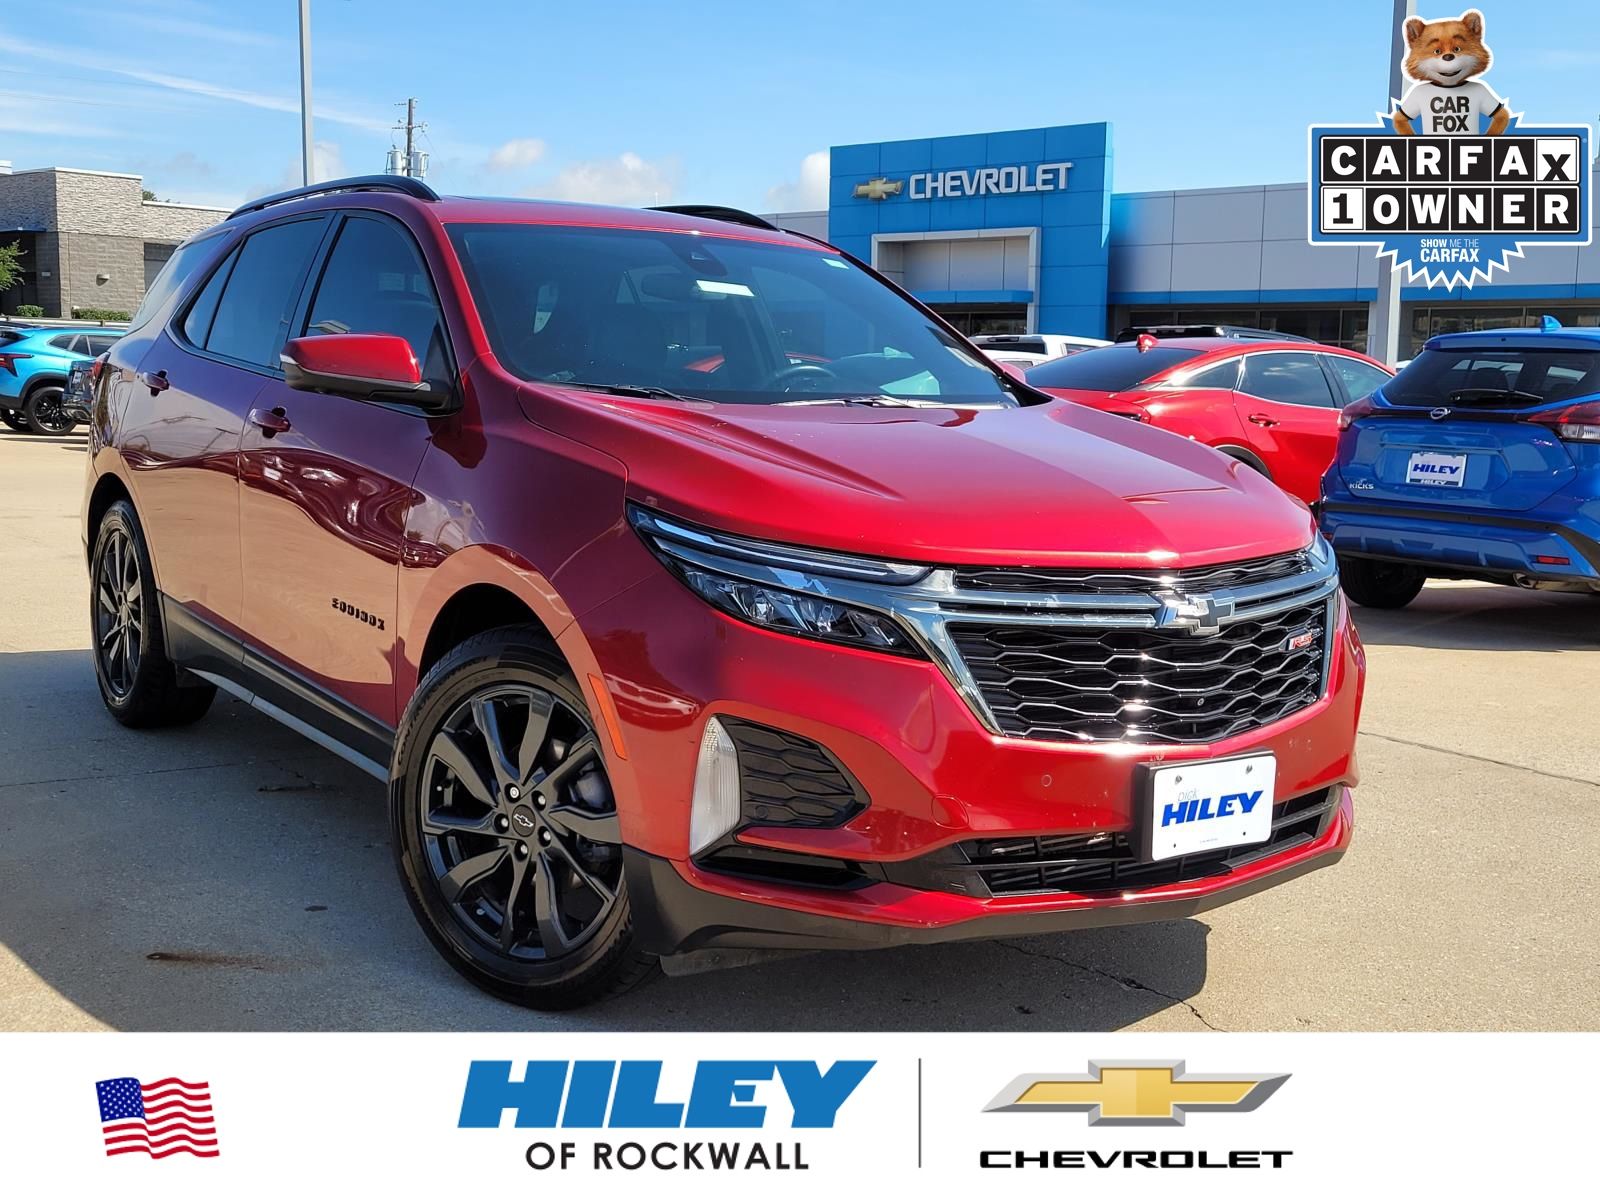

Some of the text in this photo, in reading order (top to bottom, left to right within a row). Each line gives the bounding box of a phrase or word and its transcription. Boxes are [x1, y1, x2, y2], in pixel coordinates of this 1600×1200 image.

[909, 162, 1073, 199] CHEVROLET
[1412, 463, 1460, 475] HILEY
[331, 598, 385, 631] EQUINOX
[1161, 790, 1264, 828] HILEY
